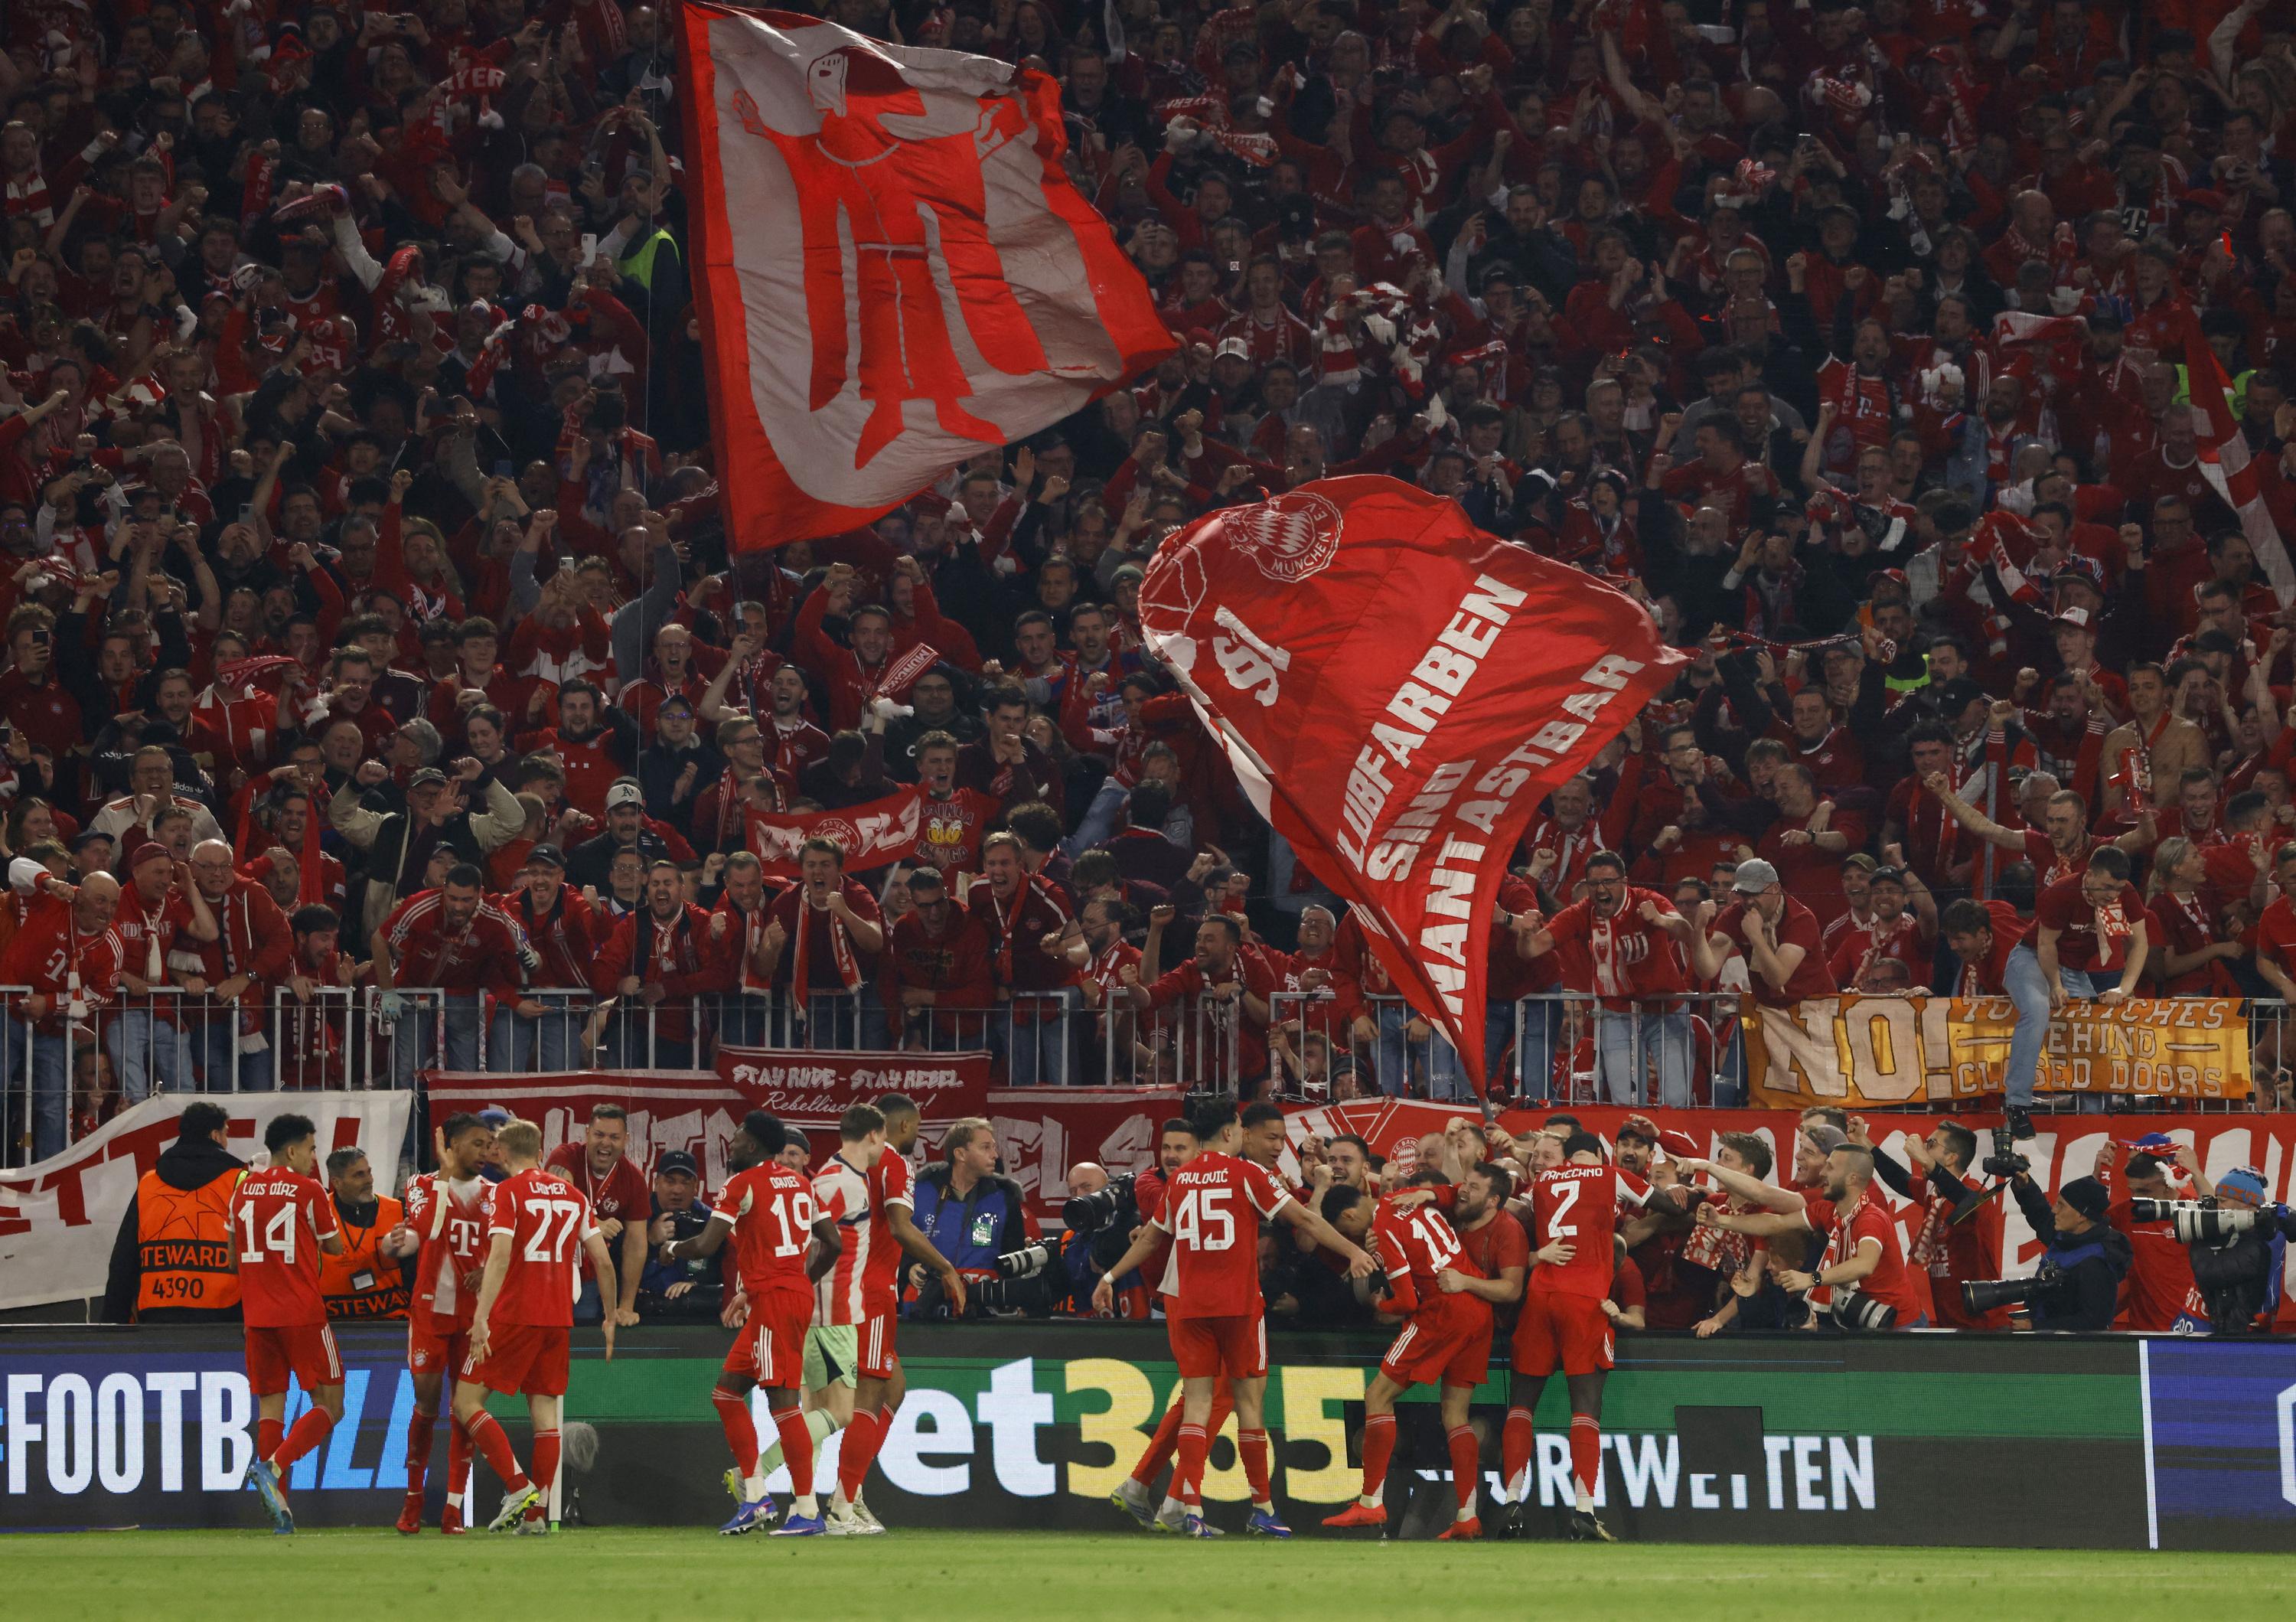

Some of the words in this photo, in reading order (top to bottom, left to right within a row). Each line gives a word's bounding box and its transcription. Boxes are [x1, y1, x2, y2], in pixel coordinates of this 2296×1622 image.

[1271, 531, 1332, 574] MÜNCHEN
[1336, 573, 1529, 876] LUBFARBEN
[1366, 759, 1476, 882] SIND
[1420, 653, 1645, 1033] NANTASTBAR
[1963, 999, 2014, 1022] TO
[1758, 997, 1952, 1101] NO!
[2047, 1022, 2157, 1059] EHIND
[732, 1065, 786, 1088] STAY
[787, 1066, 838, 1090] RUDE
[850, 1069, 902, 1090] STAY
[902, 1069, 964, 1090] REBEL
[2109, 1060, 2223, 1097] DOORS
[243, 1182, 266, 1196] LUIS
[269, 1180, 298, 1197] DÍAZ
[530, 1181, 567, 1196] LAIMER
[769, 1176, 801, 1190] DAVIES
[1176, 1167, 1229, 1185] PAVLOVIĆ
[1540, 1167, 1603, 1183] UPAMECANO
[238, 1199, 297, 1264] 14
[524, 1198, 581, 1263] 27
[770, 1192, 812, 1258] 19
[1176, 1188, 1235, 1252] 45
[1548, 1180, 1580, 1239] 2
[1410, 1206, 1462, 1274] 10
[152, 1277, 204, 1301] 4390
[0, 1369, 428, 1495] FOOTBALL
